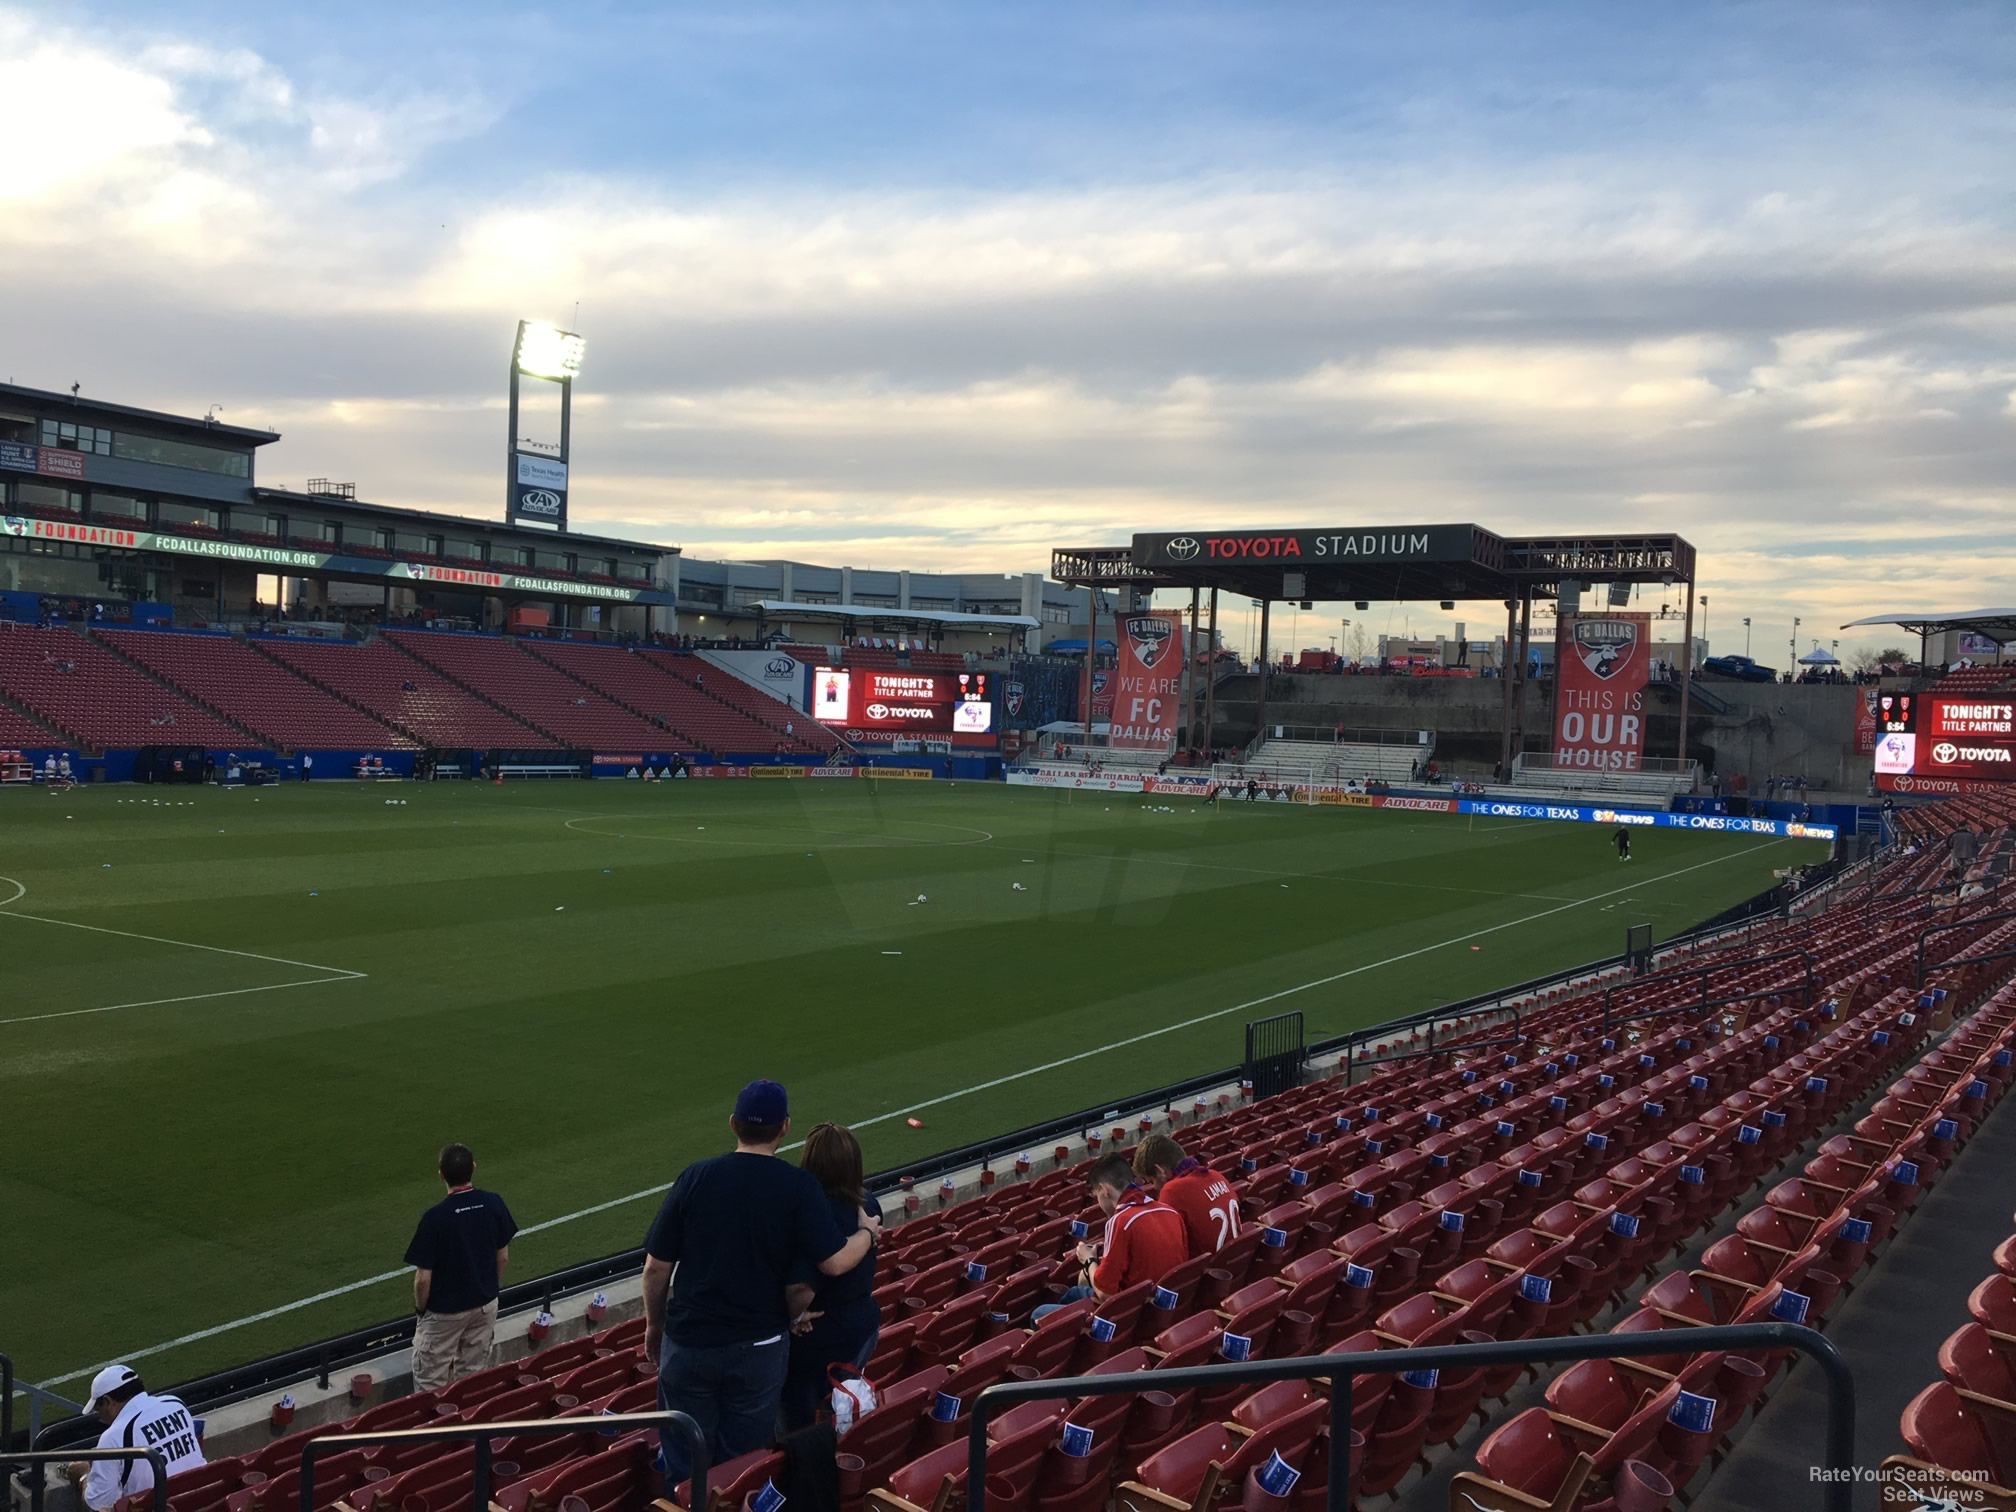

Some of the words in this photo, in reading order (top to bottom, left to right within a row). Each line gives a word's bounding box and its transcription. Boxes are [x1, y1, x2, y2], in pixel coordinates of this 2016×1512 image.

[48, 457, 82, 469] SHIELD
[48, 465, 82, 475] WINNERS
[531, 466, 546, 474] Texas
[548, 468, 565, 478] Health
[35, 520, 135, 546] FOUNDATION
[155, 536, 316, 566] FCDALLASFOUNDATION.ORG
[1206, 537, 1300, 558] TOYOTA
[1314, 533, 1429, 556] STADIUM
[428, 566, 500, 587] FOUNDATION
[515, 577, 631, 600] FCDALLASFOUNDATION.ORG
[1129, 620, 1139, 633] FC
[1142, 620, 1169, 634] DALLAS
[1578, 624, 1591, 638] FC
[1594, 624, 1632, 639] DALLAS
[874, 676, 934, 689] TONIGHT'S
[1121, 677, 1144, 693] WE
[1148, 678, 1179, 695] ARE
[874, 687, 895, 697] TITLE
[897, 689, 933, 698] PARTNER
[1565, 689, 1613, 710] THIS
[1624, 691, 1643, 711] IS
[889, 708, 933, 719] TOYOTA
[1092, 706, 1109, 716] EER
[1130, 697, 1162, 724] FC
[1942, 705, 2013, 720] TONIGHT'S
[1113, 724, 1173, 742] DALLAS
[1562, 711, 1640, 745] OUR
[1942, 720, 1965, 731] TITLE
[1968, 721, 2011, 732] PARTNER
[866, 731, 905, 742] TOYOTA
[909, 733, 953, 743] STADIUM
[1558, 748, 1637, 769] HOUSE
[1959, 748, 2012, 762] TOYOTA
[751, 766, 785, 777] Continental
[811, 767, 852, 777] ADVOCARE
[861, 767, 905, 778] Continental
[1153, 783, 1207, 795] ADVOCARE
[1916, 779, 1960, 793] TOYOTA
[1965, 783, 2007, 793] STAD
[1351, 796, 1370, 805] TIRE
[1384, 797, 1449, 811] ADVOCARE
[1472, 803, 1488, 814] THE
[1491, 804, 1521, 816] ONES
[1523, 806, 1544, 817] FOR
[1546, 808, 1579, 819] TEXAS
[1614, 814, 1654, 825] NEWS
[1669, 815, 1687, 826] THE
[1691, 816, 1724, 829] ONES
[1726, 819, 1750, 831] FOR
[1751, 822, 1775, 833] TEXAS
[1804, 827, 1834, 839] NEWS
[140, 1409, 189, 1445] EVENT
[153, 1432, 196, 1466] STAFF
